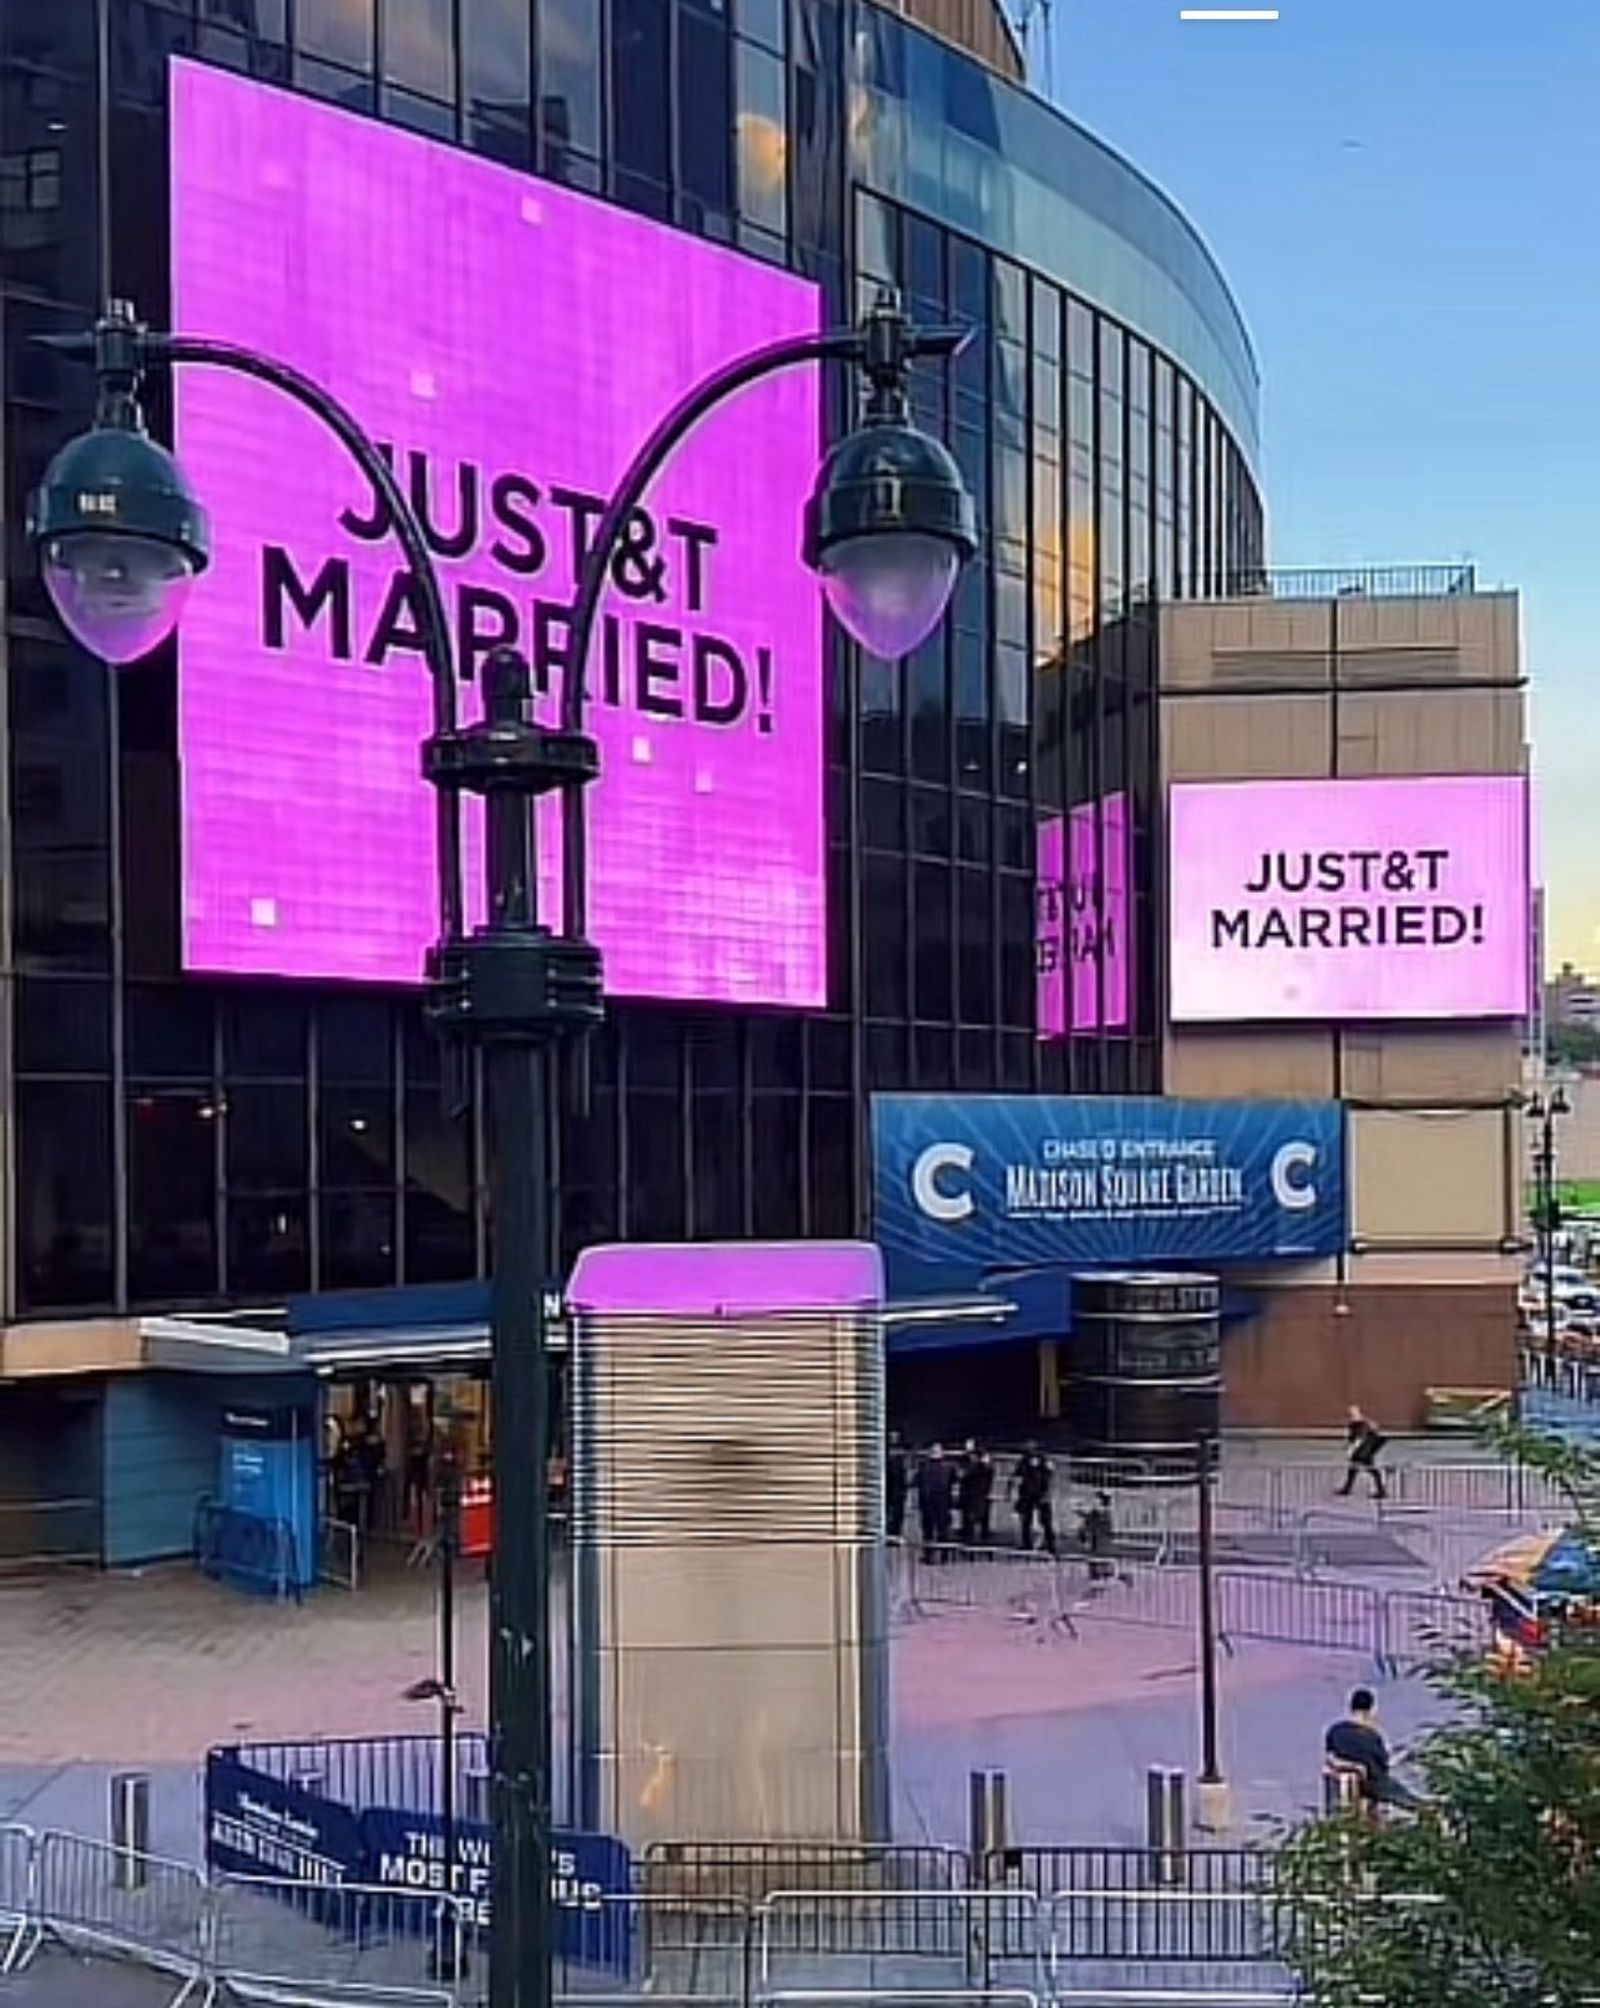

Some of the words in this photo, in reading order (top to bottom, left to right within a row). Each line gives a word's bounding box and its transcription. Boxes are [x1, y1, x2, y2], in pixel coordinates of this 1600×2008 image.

[1244, 850, 1450, 892] JUST&T
[1210, 903, 1485, 949] MARRIED!
[912, 1142, 975, 1220] C
[1006, 1163, 1098, 1208] MADISON
[1102, 1163, 1171, 1207] SQUARE
[1175, 1163, 1243, 1204] GARDEN
[1270, 1140, 1317, 1209] C
